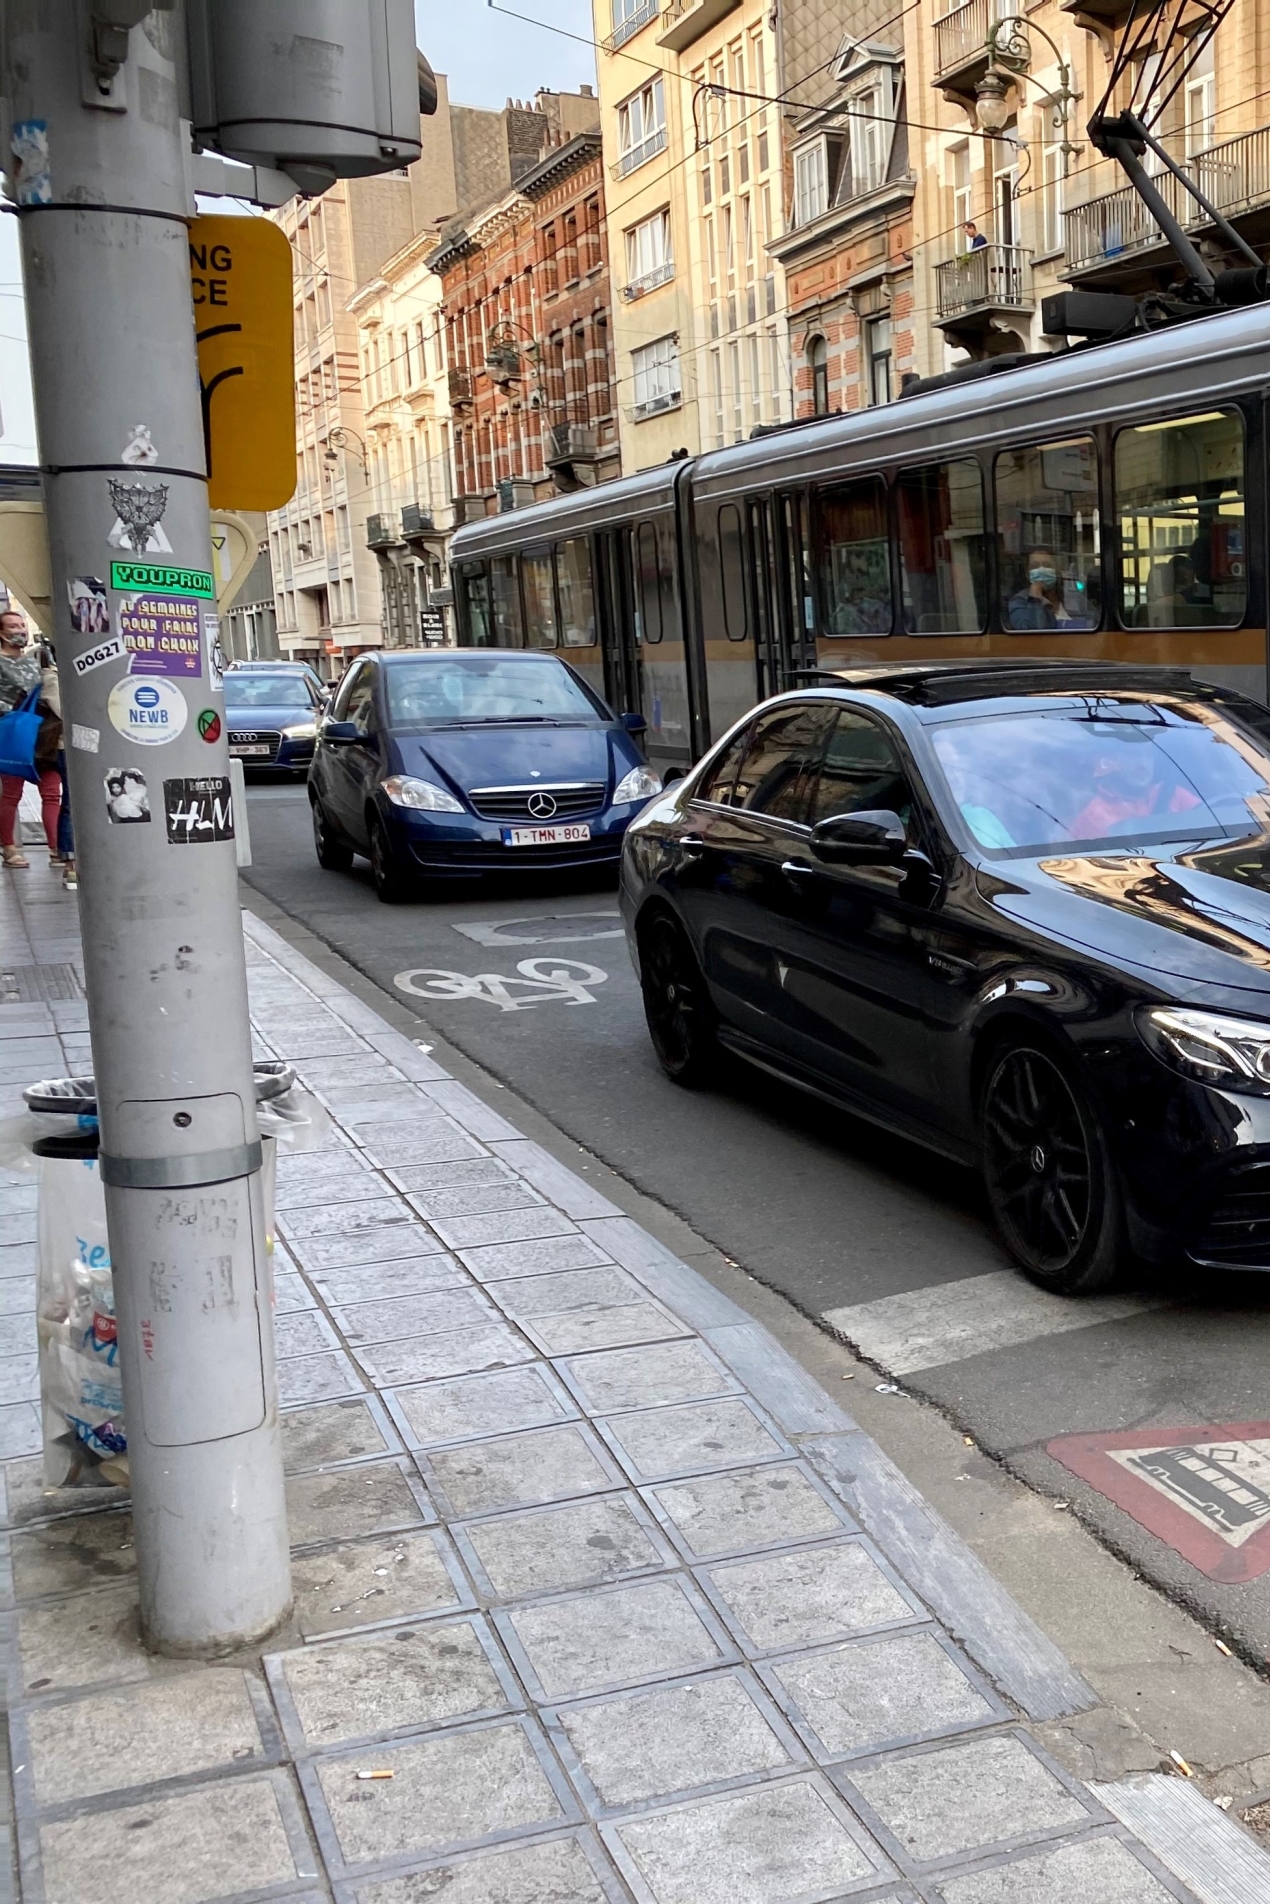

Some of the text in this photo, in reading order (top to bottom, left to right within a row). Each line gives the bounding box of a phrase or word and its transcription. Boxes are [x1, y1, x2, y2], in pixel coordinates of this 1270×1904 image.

[189, 244, 232, 271] NG
[191, 277, 228, 306] CE
[116, 565, 212, 592] YOUPRON
[139, 601, 198, 618] SEMAINES
[122, 617, 158, 632] POUR
[163, 620, 198, 635] FAIRE
[123, 634, 199, 654] MON CHOIX
[75, 641, 121, 671] DOG27
[129, 709, 169, 723] NEWB
[189, 780, 223, 791] HELLO
